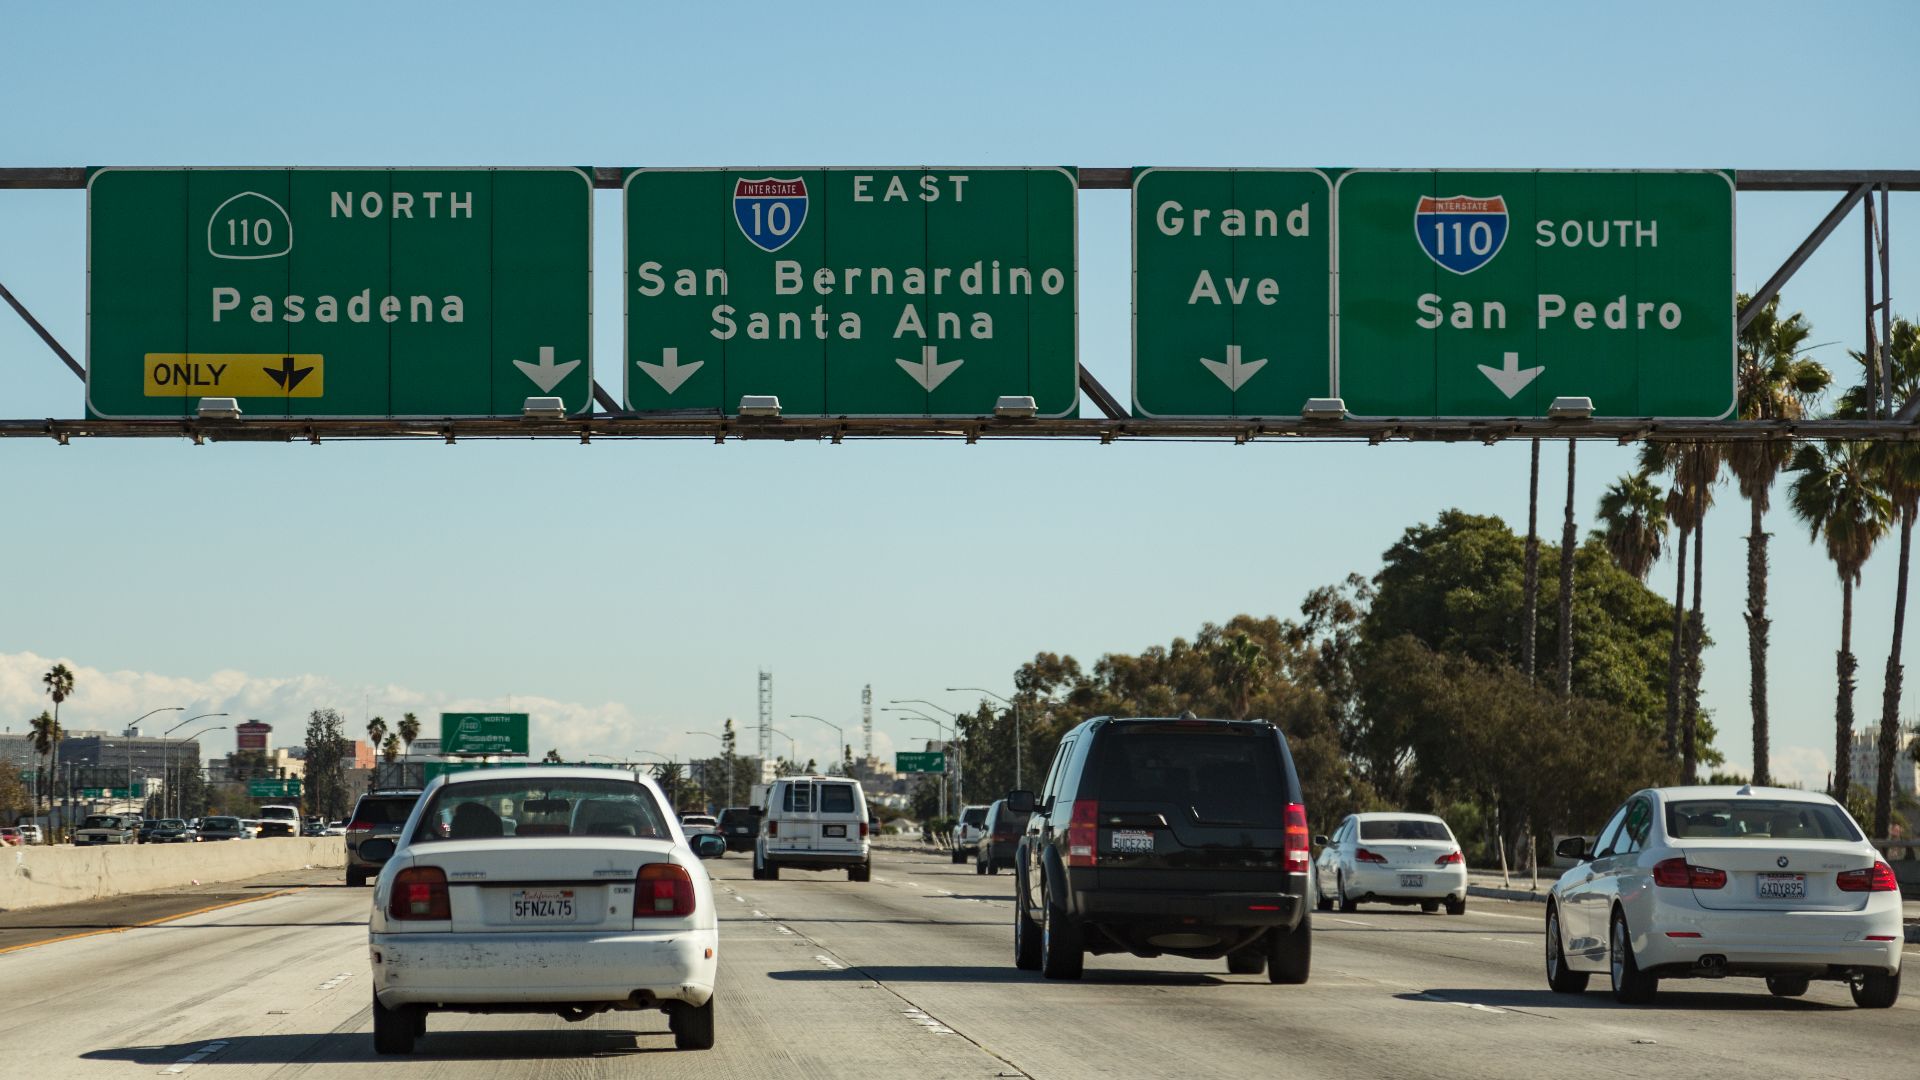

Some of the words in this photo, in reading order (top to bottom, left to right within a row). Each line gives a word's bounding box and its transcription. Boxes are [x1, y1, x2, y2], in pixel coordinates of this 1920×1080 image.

[744, 184, 797, 195] INTERSTATE
[853, 175, 969, 202] EAST
[331, 191, 472, 219] NORTH
[751, 202, 791, 236] 10
[1156, 200, 1309, 237] Grand
[227, 218, 273, 246] 110
[1435, 221, 1493, 256] 110
[1536, 219, 1658, 248] SOUTH
[638, 261, 728, 297] San
[775, 260, 1065, 296] Bernardino
[1188, 269, 1280, 306] Ave
[212, 287, 464, 323] Pasadena
[1416, 293, 1506, 329] San
[1538, 294, 1682, 330] Pedro
[710, 304, 861, 340] Santa
[893, 303, 993, 340] Ana
[153, 363, 227, 386] ONLY
[1761, 882, 1803, 896] 6XDY895
[515, 900, 572, 917] 5FNZ475
